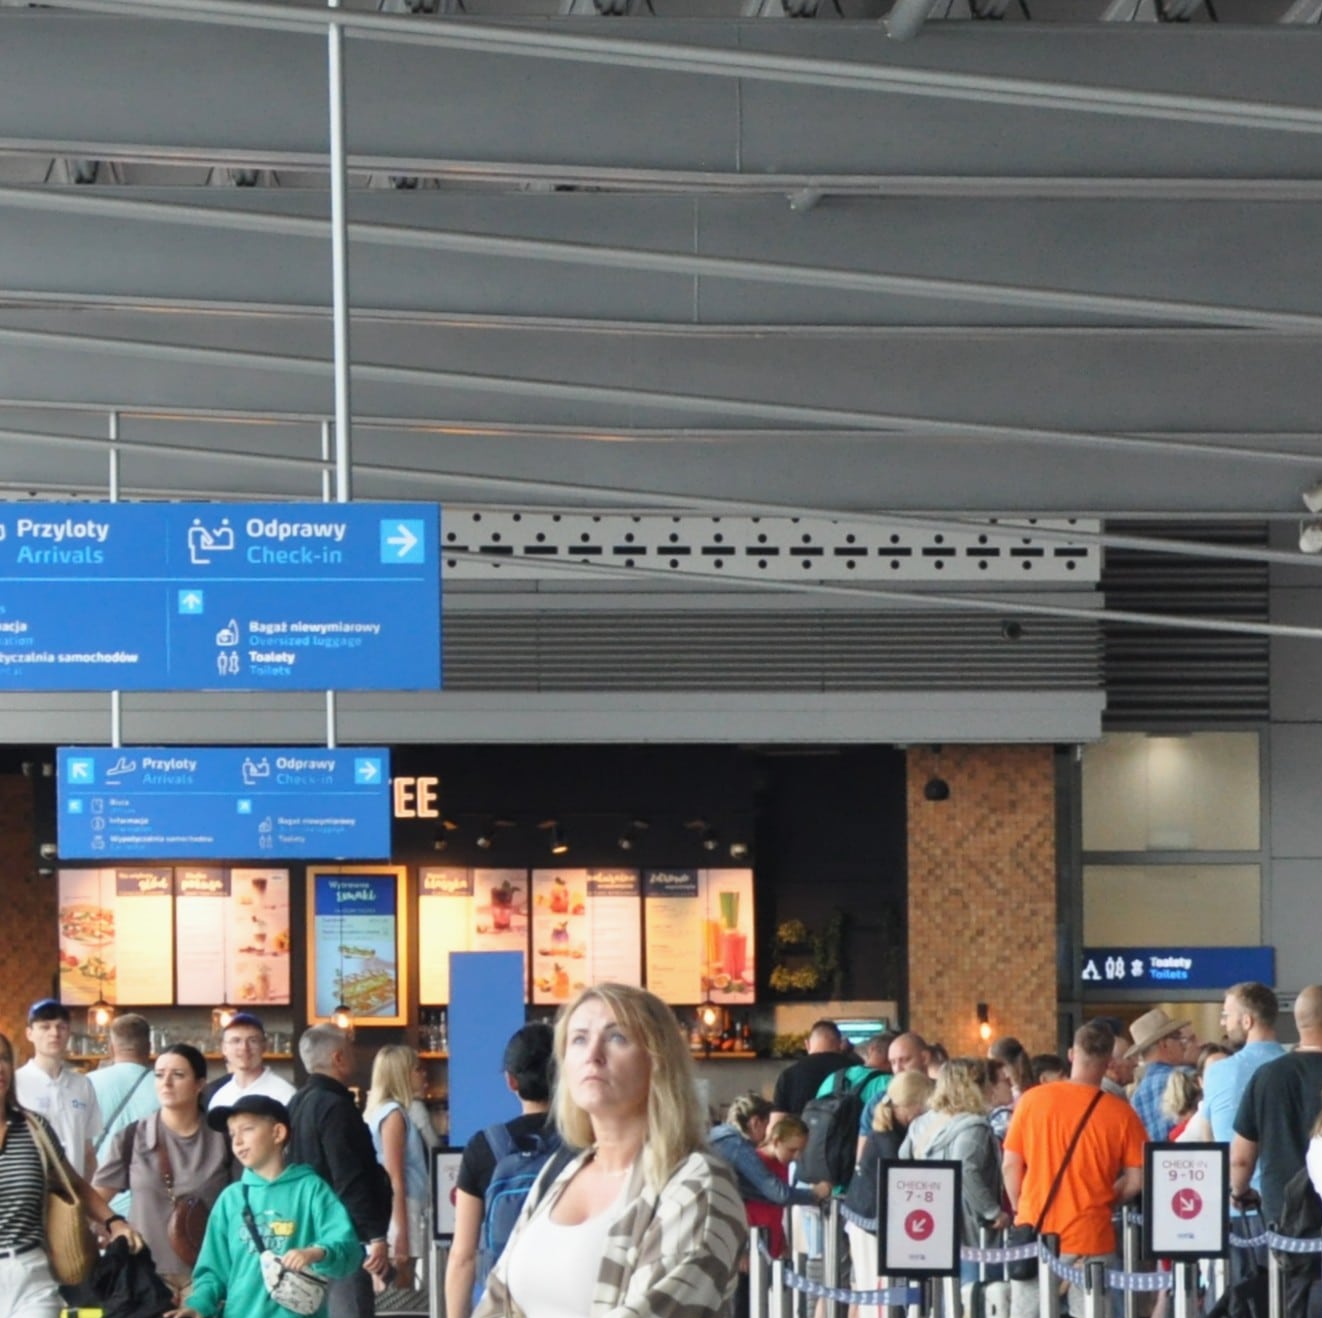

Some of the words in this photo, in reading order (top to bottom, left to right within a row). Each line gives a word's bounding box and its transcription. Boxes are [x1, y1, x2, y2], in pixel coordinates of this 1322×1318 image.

[16, 518, 110, 544] Przyloty
[246, 518, 347, 545] Odprawy
[16, 546, 105, 565] Arrivals
[246, 546, 343, 565] Check-in
[248, 620, 289, 635] Bagaż
[289, 621, 381, 635] niewymiarowy
[57, 650, 139, 664] samochodów
[248, 651, 296, 665] Toalety
[142, 757, 197, 772] Przyloty
[276, 758, 336, 773] Odprawy
[1169, 1170, 1178, 1181] 9
[1189, 1169, 1205, 1181] 10
[905, 1190, 914, 1202] 7
[924, 1191, 934, 1203] 8
